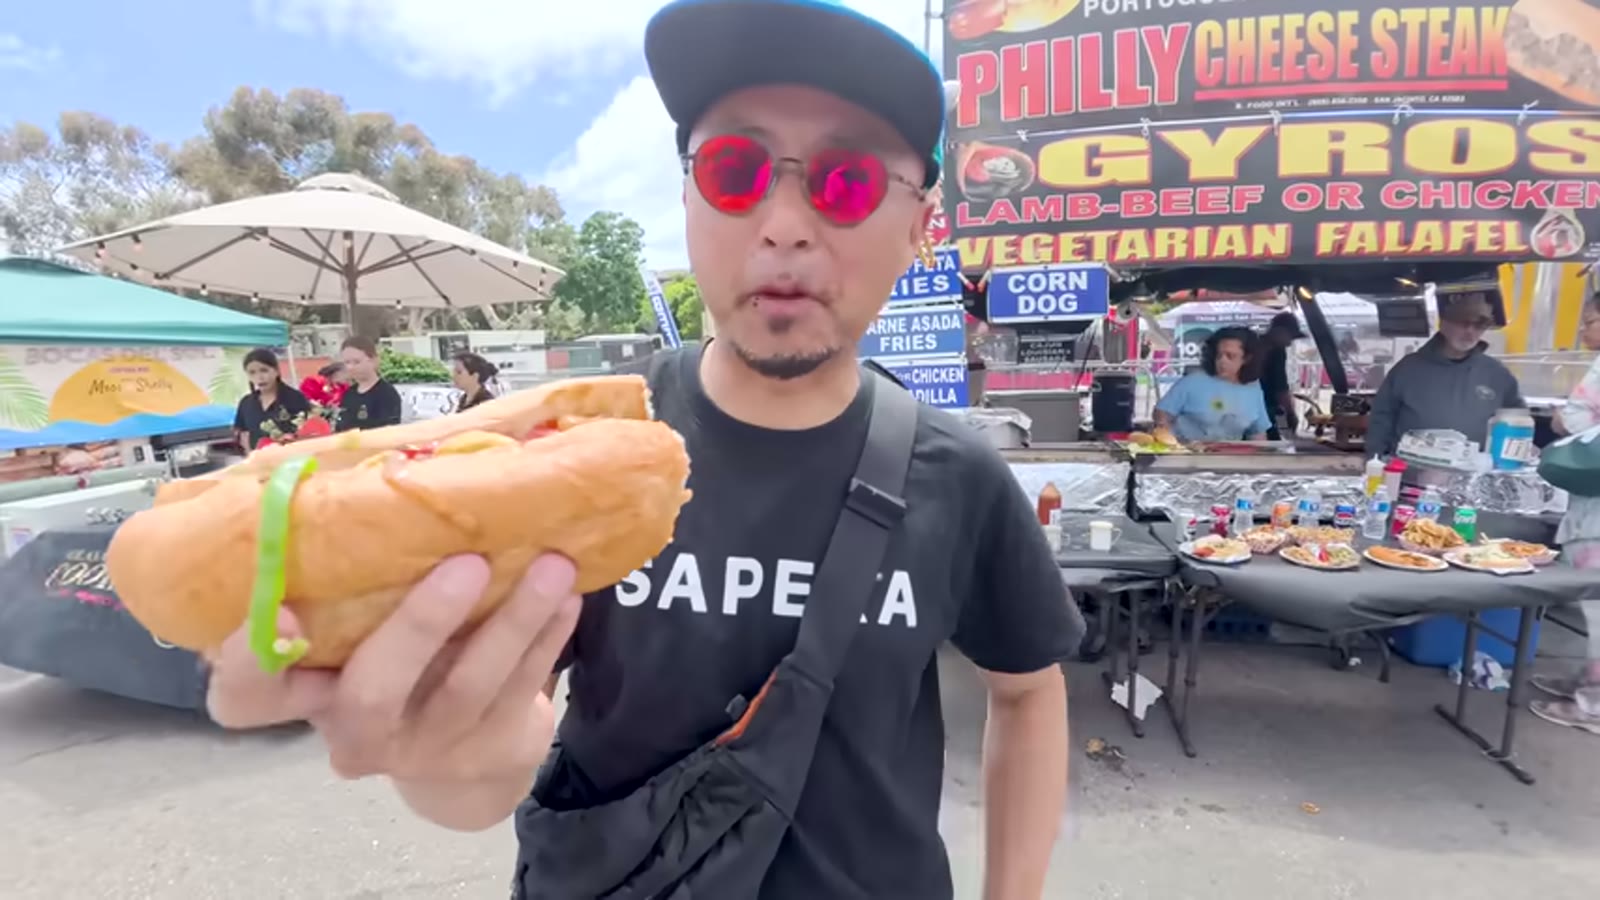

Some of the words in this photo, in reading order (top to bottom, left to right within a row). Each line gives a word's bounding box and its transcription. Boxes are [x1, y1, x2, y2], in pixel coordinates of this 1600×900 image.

[957, 22, 1192, 128] PHILLY
[1194, 10, 1360, 88] CHEESE
[1370, 6, 1509, 80] STEAK
[1038, 119, 1600, 189] GYROS
[956, 185, 1265, 228] LAMB-BEEF
[1281, 181, 1364, 211] OR
[956, 222, 1292, 270] VEGETARIAN
[1316, 219, 1528, 257] FALAFEL
[1007, 271, 1088, 294] CORN
[1018, 294, 1078, 315] DOG
[866, 317, 908, 336] ARNE
[911, 313, 962, 333] ASADA
[880, 333, 938, 352] FRIES
[912, 367, 964, 384] CHICKEN
[615, 552, 918, 628] SAPEA
